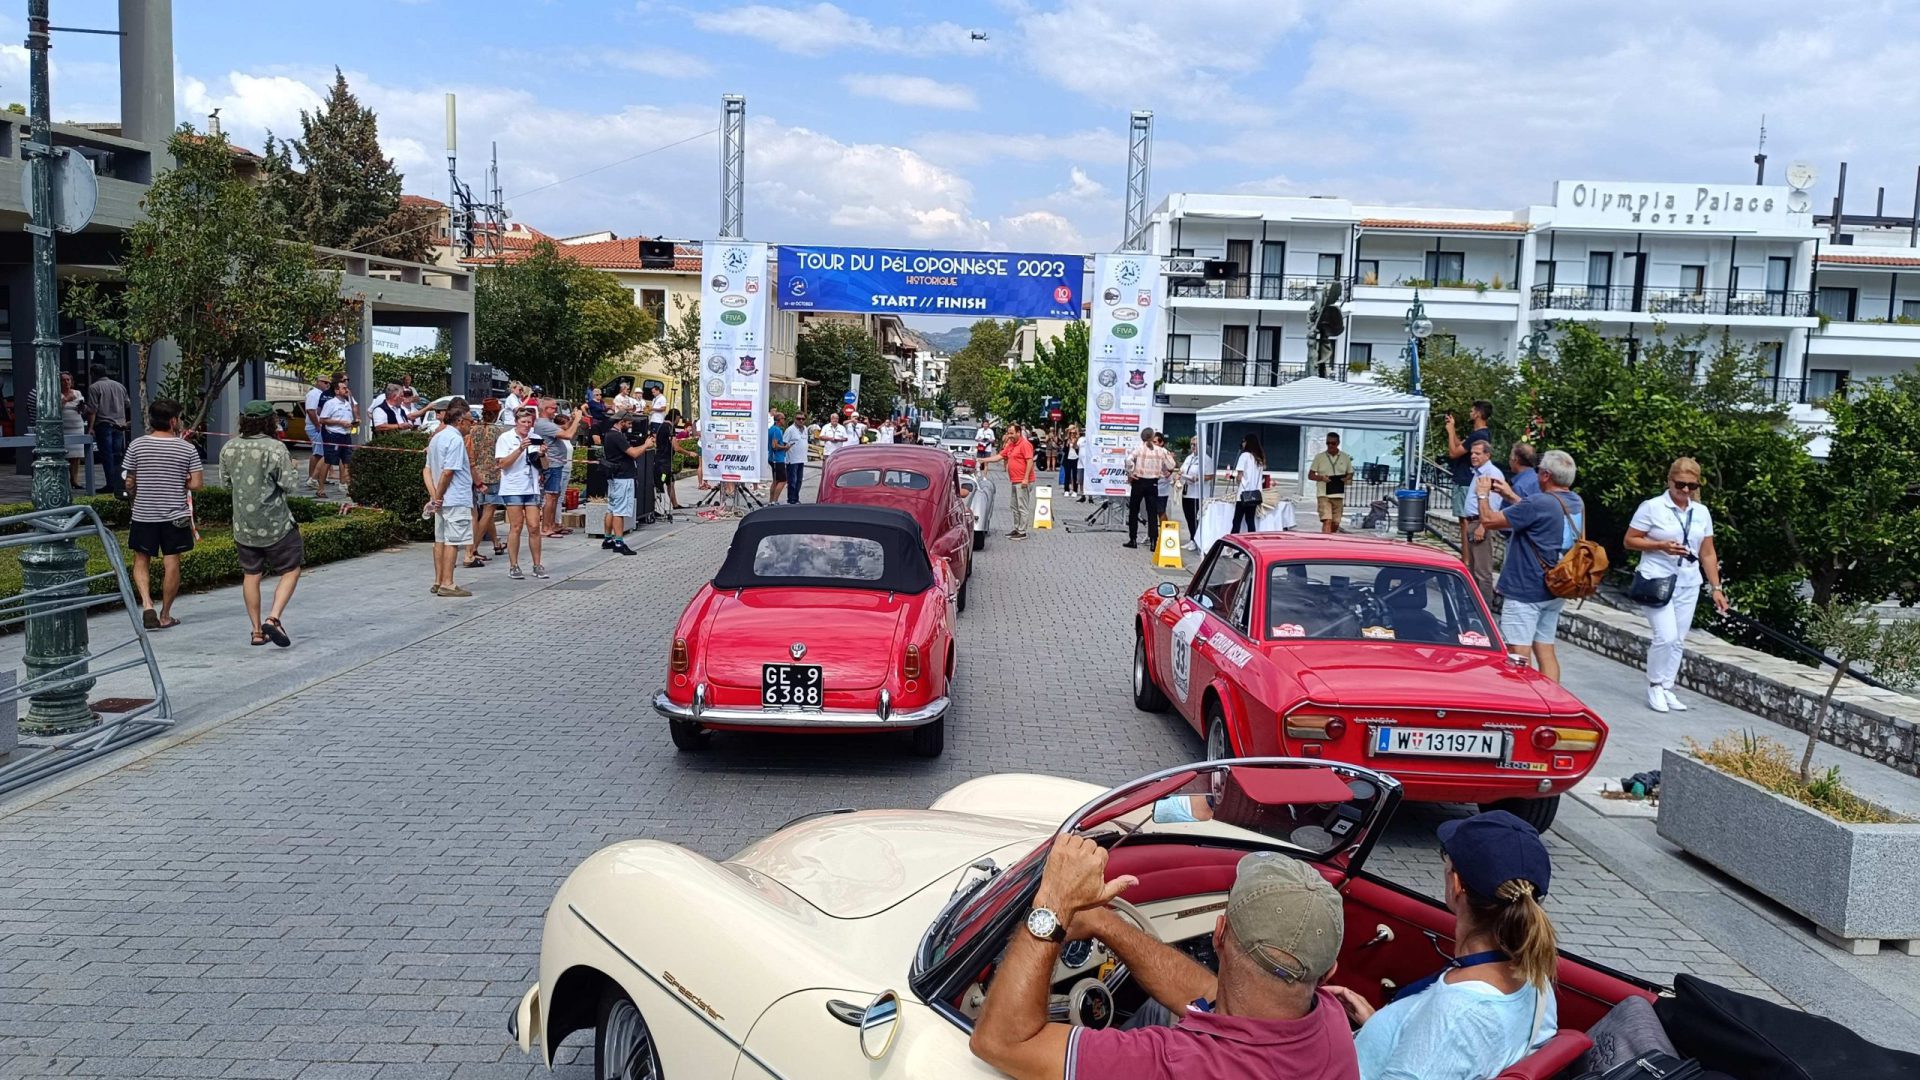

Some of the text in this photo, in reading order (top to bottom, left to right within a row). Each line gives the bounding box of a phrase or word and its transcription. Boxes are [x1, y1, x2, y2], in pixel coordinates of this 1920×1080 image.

[1573, 184, 1774, 213] Olympia Palace
[796, 252, 845, 271] TOUR
[850, 254, 875, 272] DU
[1017, 259, 1066, 278] 2023
[905, 275, 958, 286] HISTORIQUE
[1057, 287, 1069, 298] 10
[871, 294, 918, 308] START
[936, 296, 987, 310] FINISH
[1116, 327, 1134, 335] FIVA
[1175, 639, 1187, 675] 33
[765, 666, 818, 684] GE 9
[765, 686, 818, 704] 6388
[1380, 741, 1387, 749] A
[1397, 731, 1494, 753] W 13197 N
[662, 970, 726, 1021] Speedster
